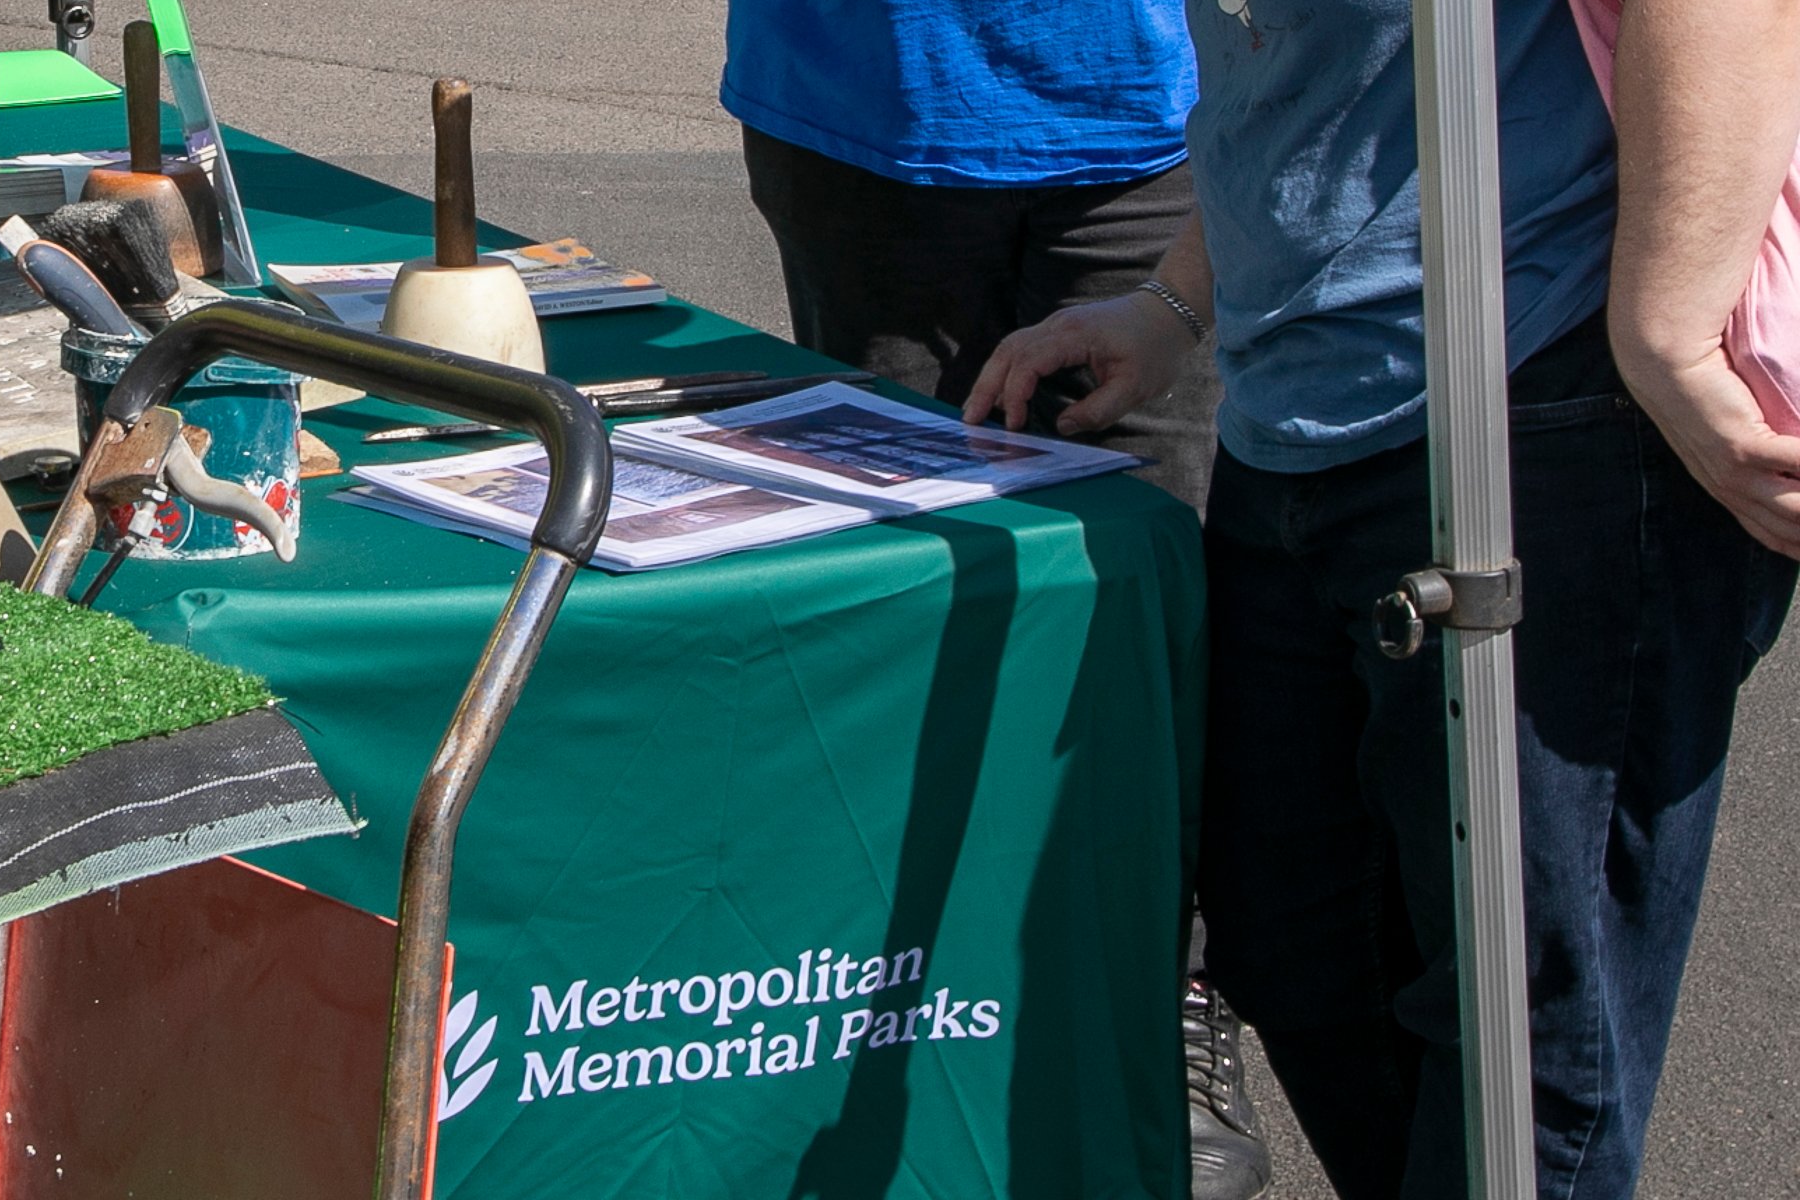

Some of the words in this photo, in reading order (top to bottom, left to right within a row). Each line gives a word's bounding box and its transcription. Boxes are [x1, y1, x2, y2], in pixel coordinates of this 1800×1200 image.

[525, 946, 924, 1036] Metropolitan
[517, 1015, 821, 1102] Memorial
[832, 987, 1000, 1060] Parks
